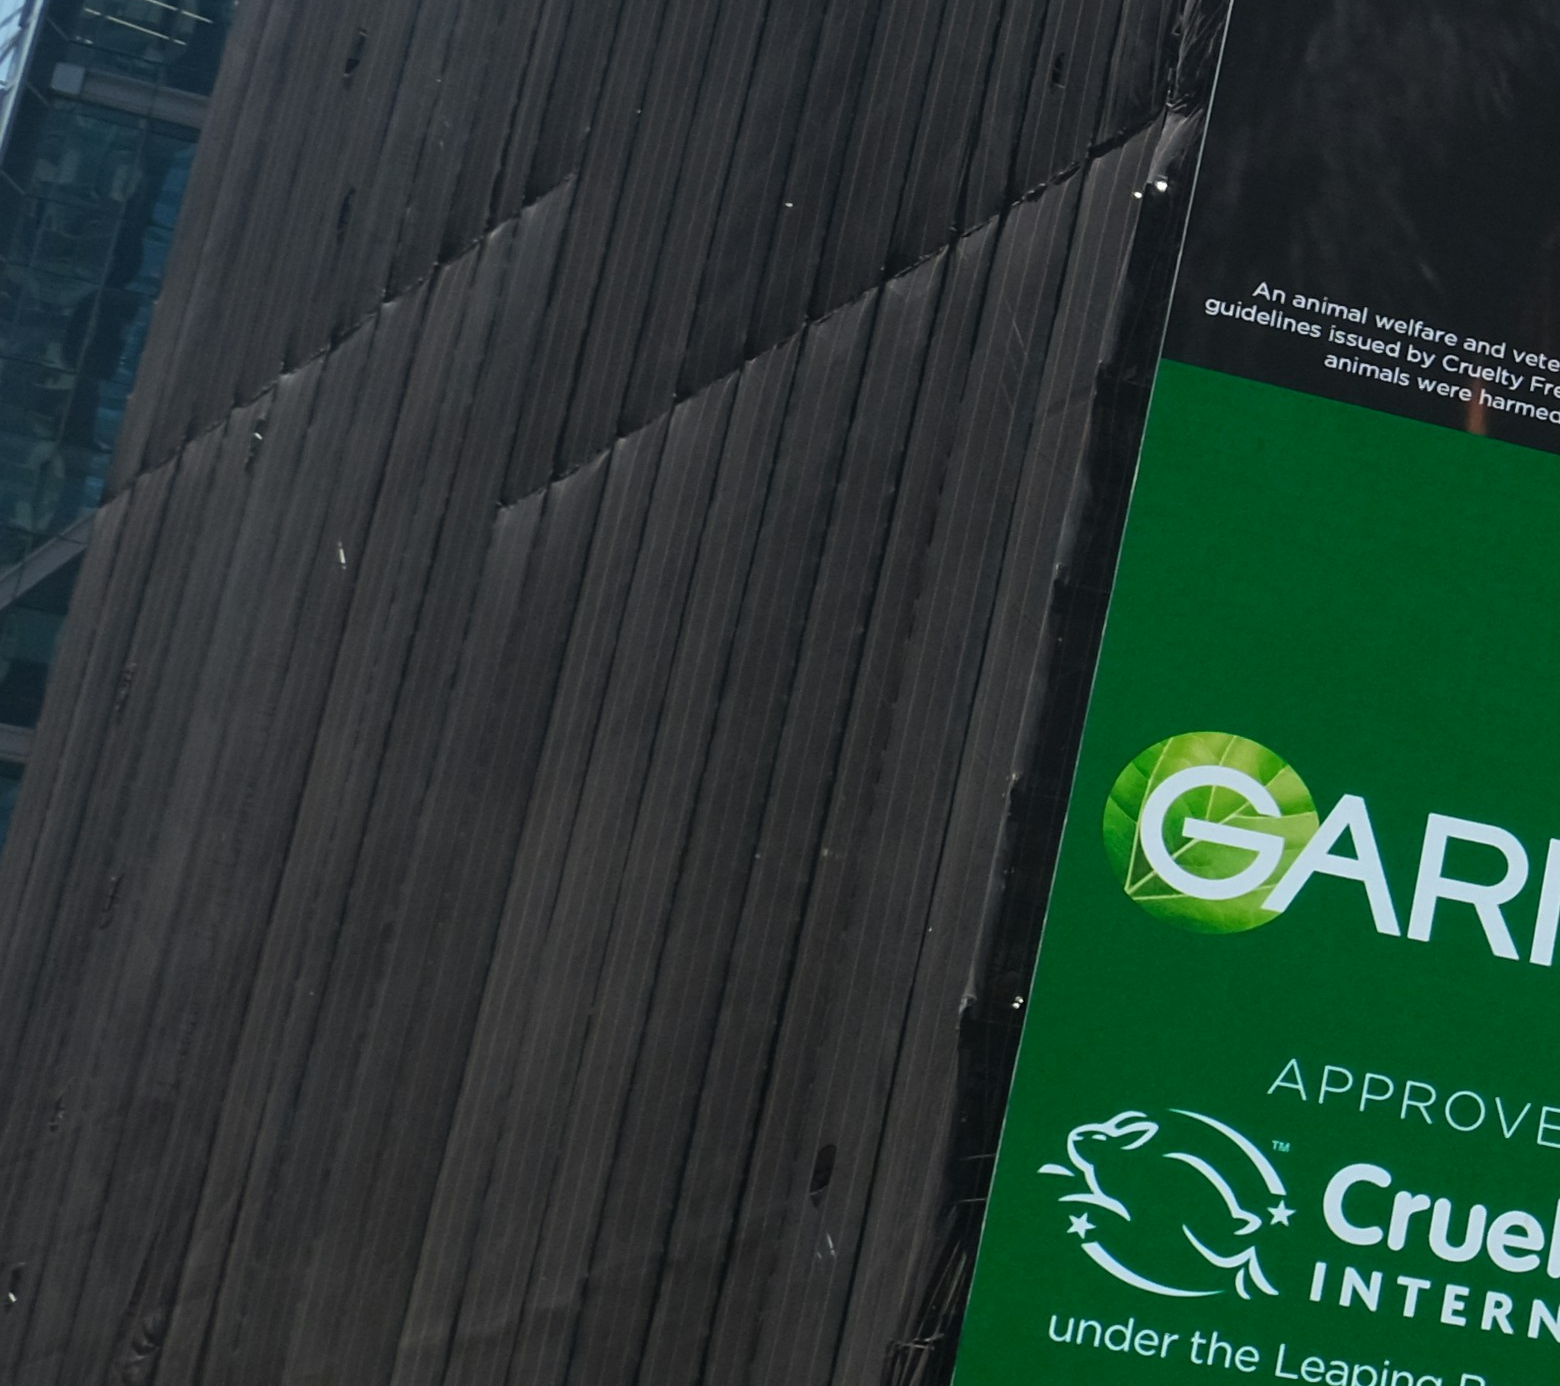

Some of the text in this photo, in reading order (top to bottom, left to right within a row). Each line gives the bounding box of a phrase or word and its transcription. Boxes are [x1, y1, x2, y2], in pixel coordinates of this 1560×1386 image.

[1205, 298, 1322, 338] guidelines
[1329, 324, 1401, 358] issued
[1406, 344, 1436, 369] by
[1442, 354, 1524, 391] Cruelty
[1252, 282, 1286, 304] An
[1292, 294, 1368, 324] animal
[1375, 315, 1458, 346] welfare
[1463, 338, 1506, 359] and
[1324, 354, 1410, 386] animals
[1417, 377, 1472, 402] were
[1048, 1315, 1179, 1358] under
[1190, 1331, 1260, 1372] the
